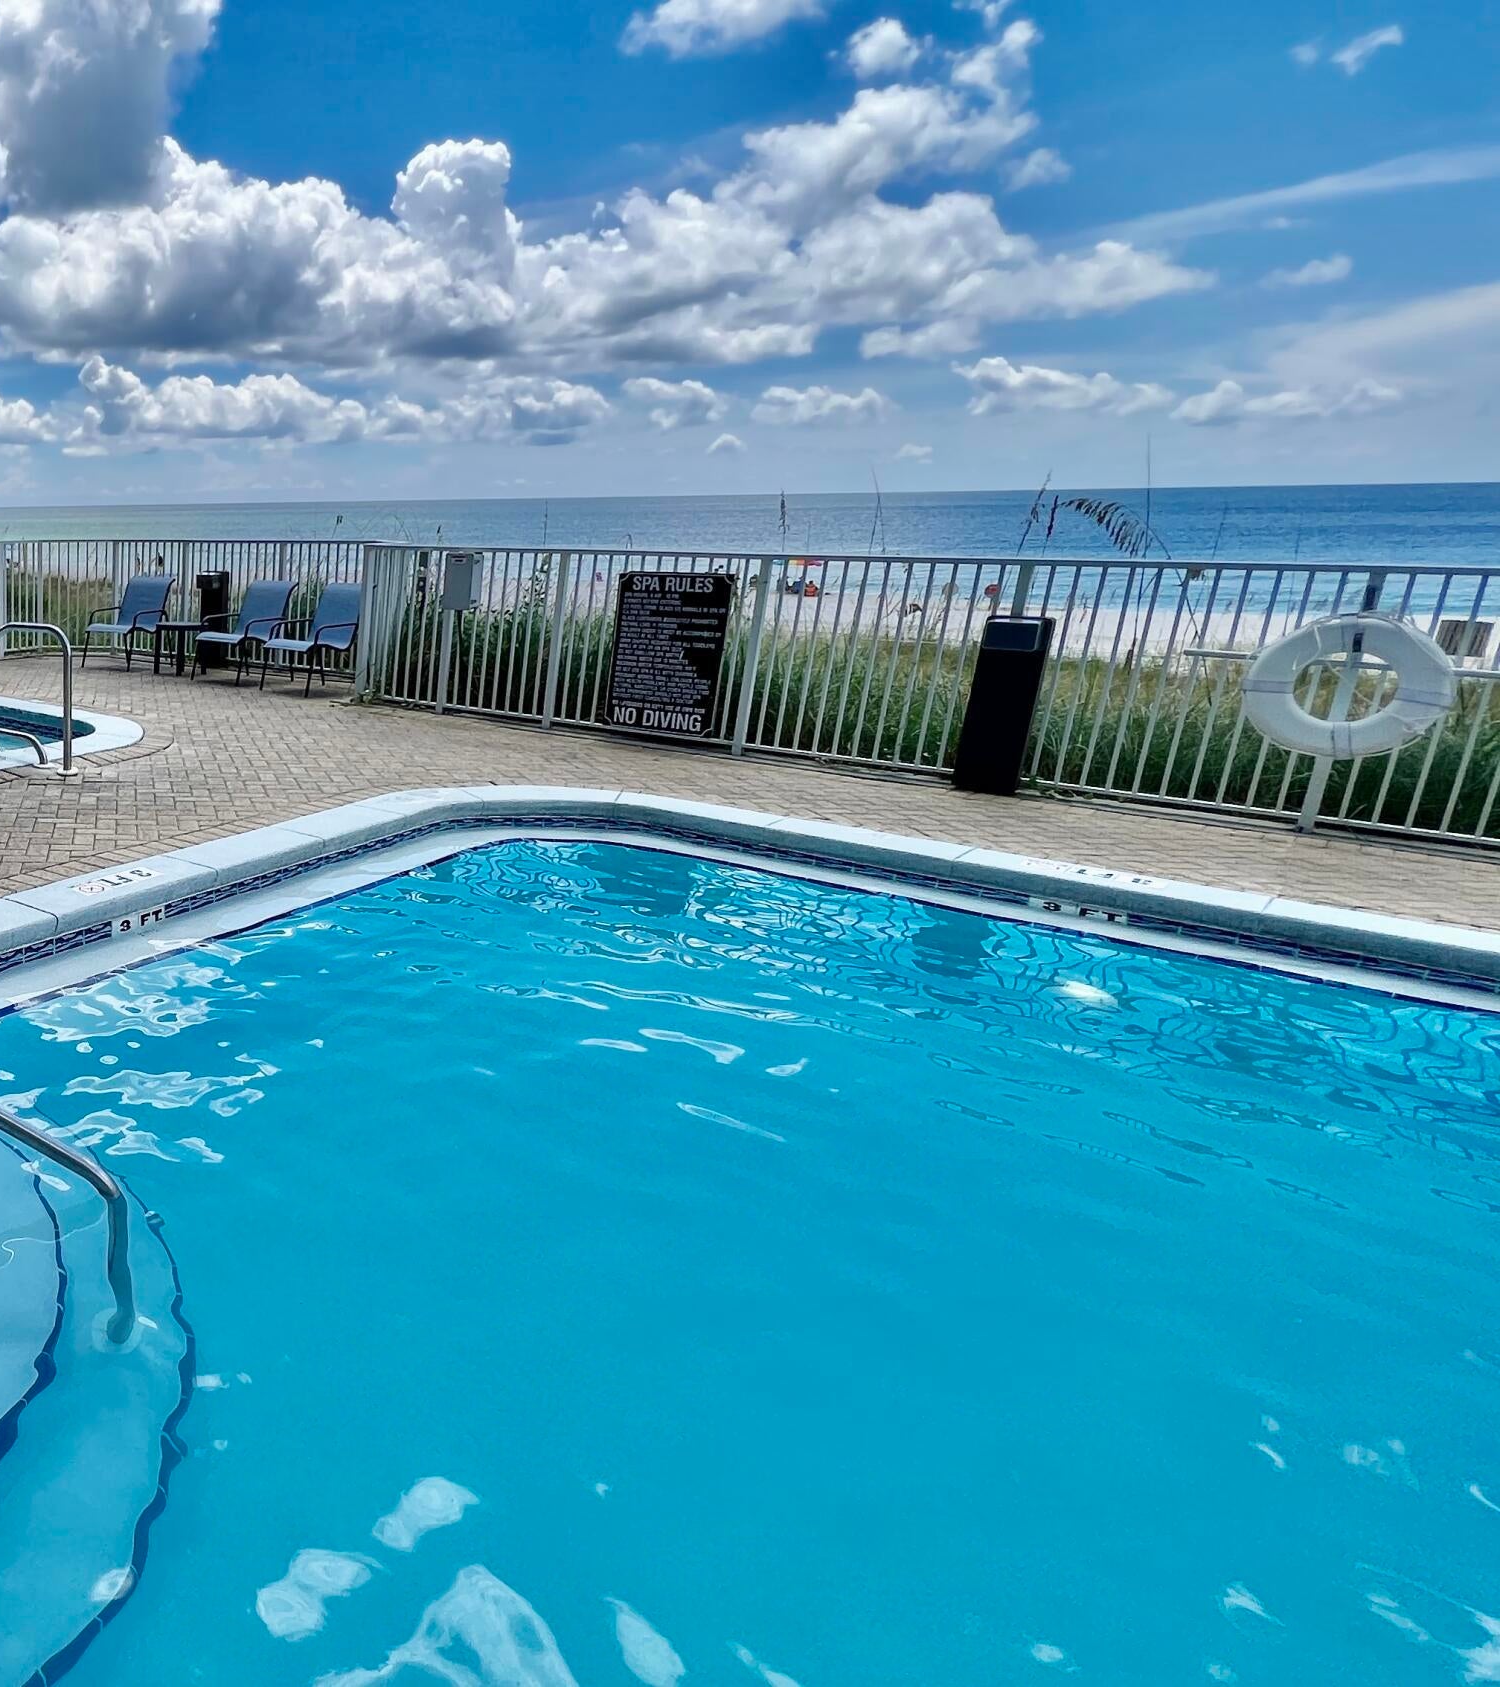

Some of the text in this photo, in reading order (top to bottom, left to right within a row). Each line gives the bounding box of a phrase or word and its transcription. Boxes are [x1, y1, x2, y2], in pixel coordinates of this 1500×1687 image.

[632, 576, 714, 593] SPA RULES
[613, 707, 701, 732] NO DIVING
[1042, 901, 1061, 911] 3
[120, 920, 131, 931] 3
